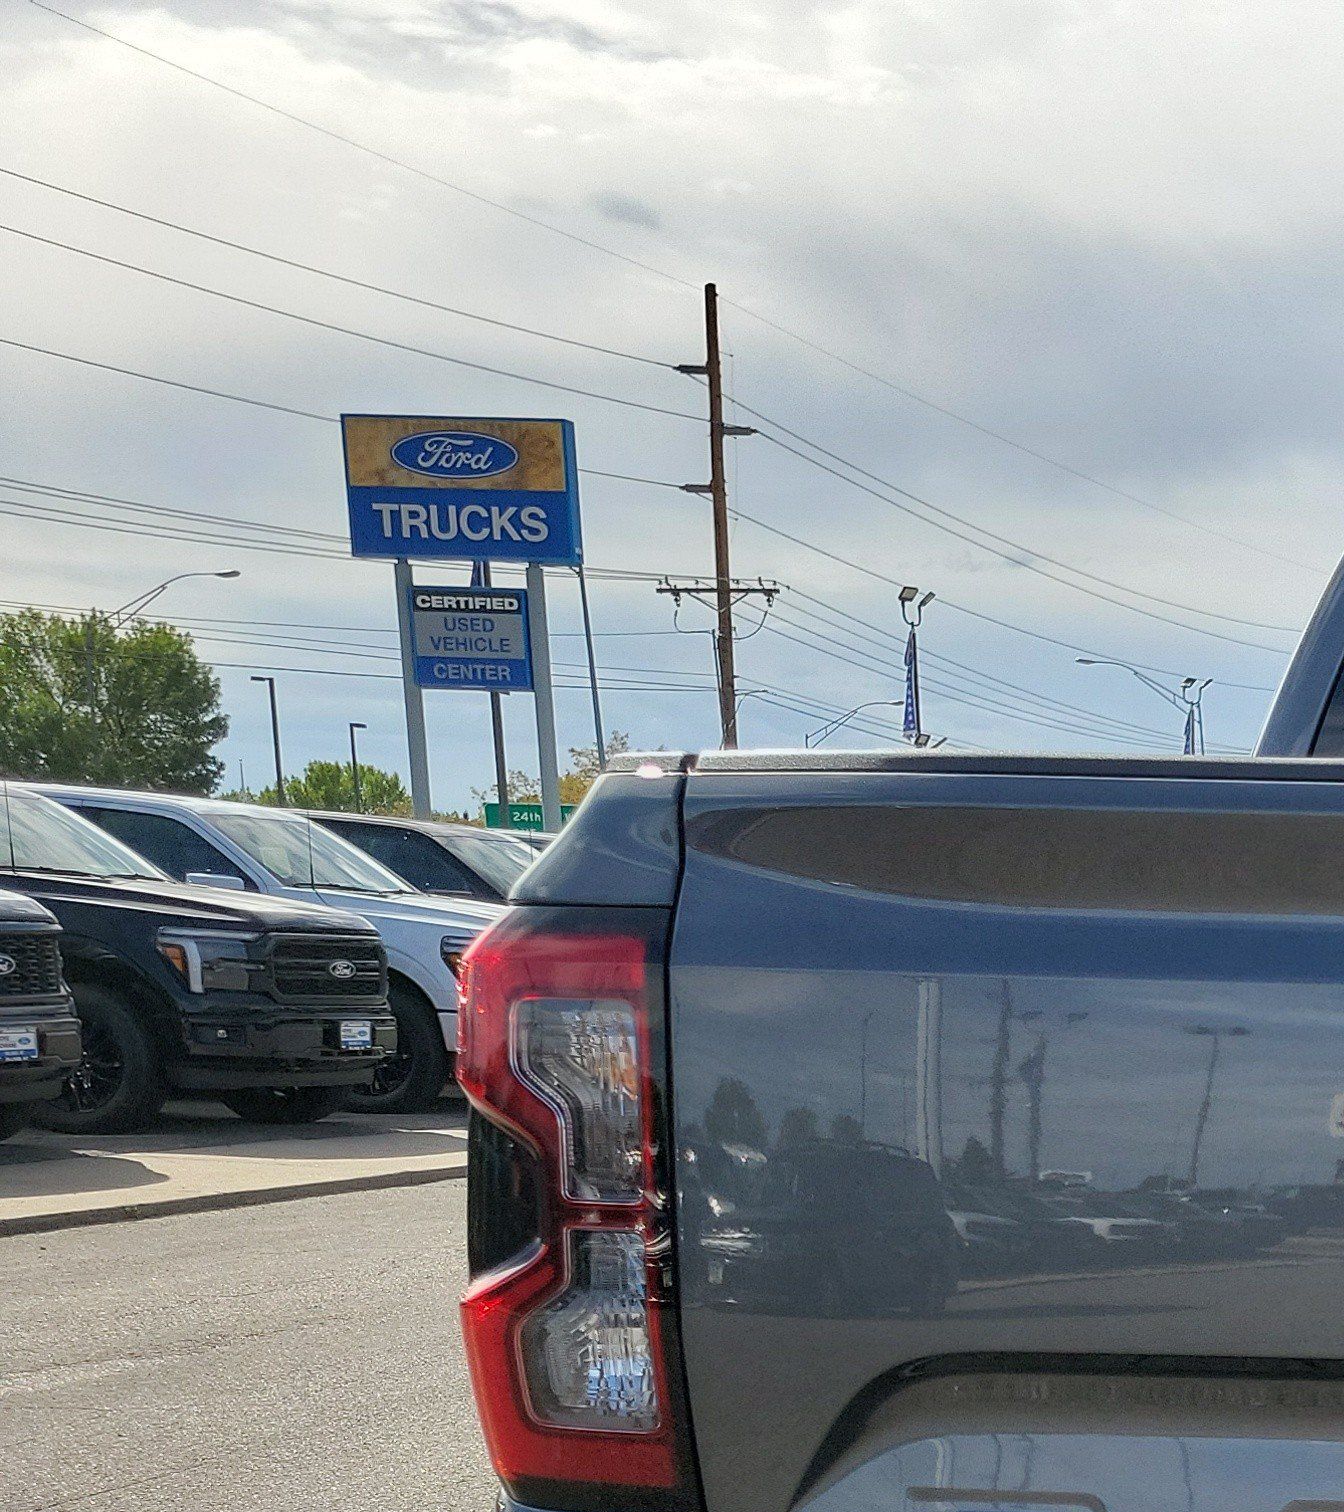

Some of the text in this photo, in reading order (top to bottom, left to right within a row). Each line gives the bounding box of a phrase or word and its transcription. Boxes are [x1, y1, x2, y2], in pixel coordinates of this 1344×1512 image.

[417, 436, 494, 471] Ford
[371, 502, 550, 543] TRUCKS
[415, 594, 520, 611] CERTIFIED
[443, 617, 496, 633] USED
[429, 635, 511, 653] VEHICLE
[432, 662, 512, 682] CENTER
[512, 811, 541, 822] 24th
